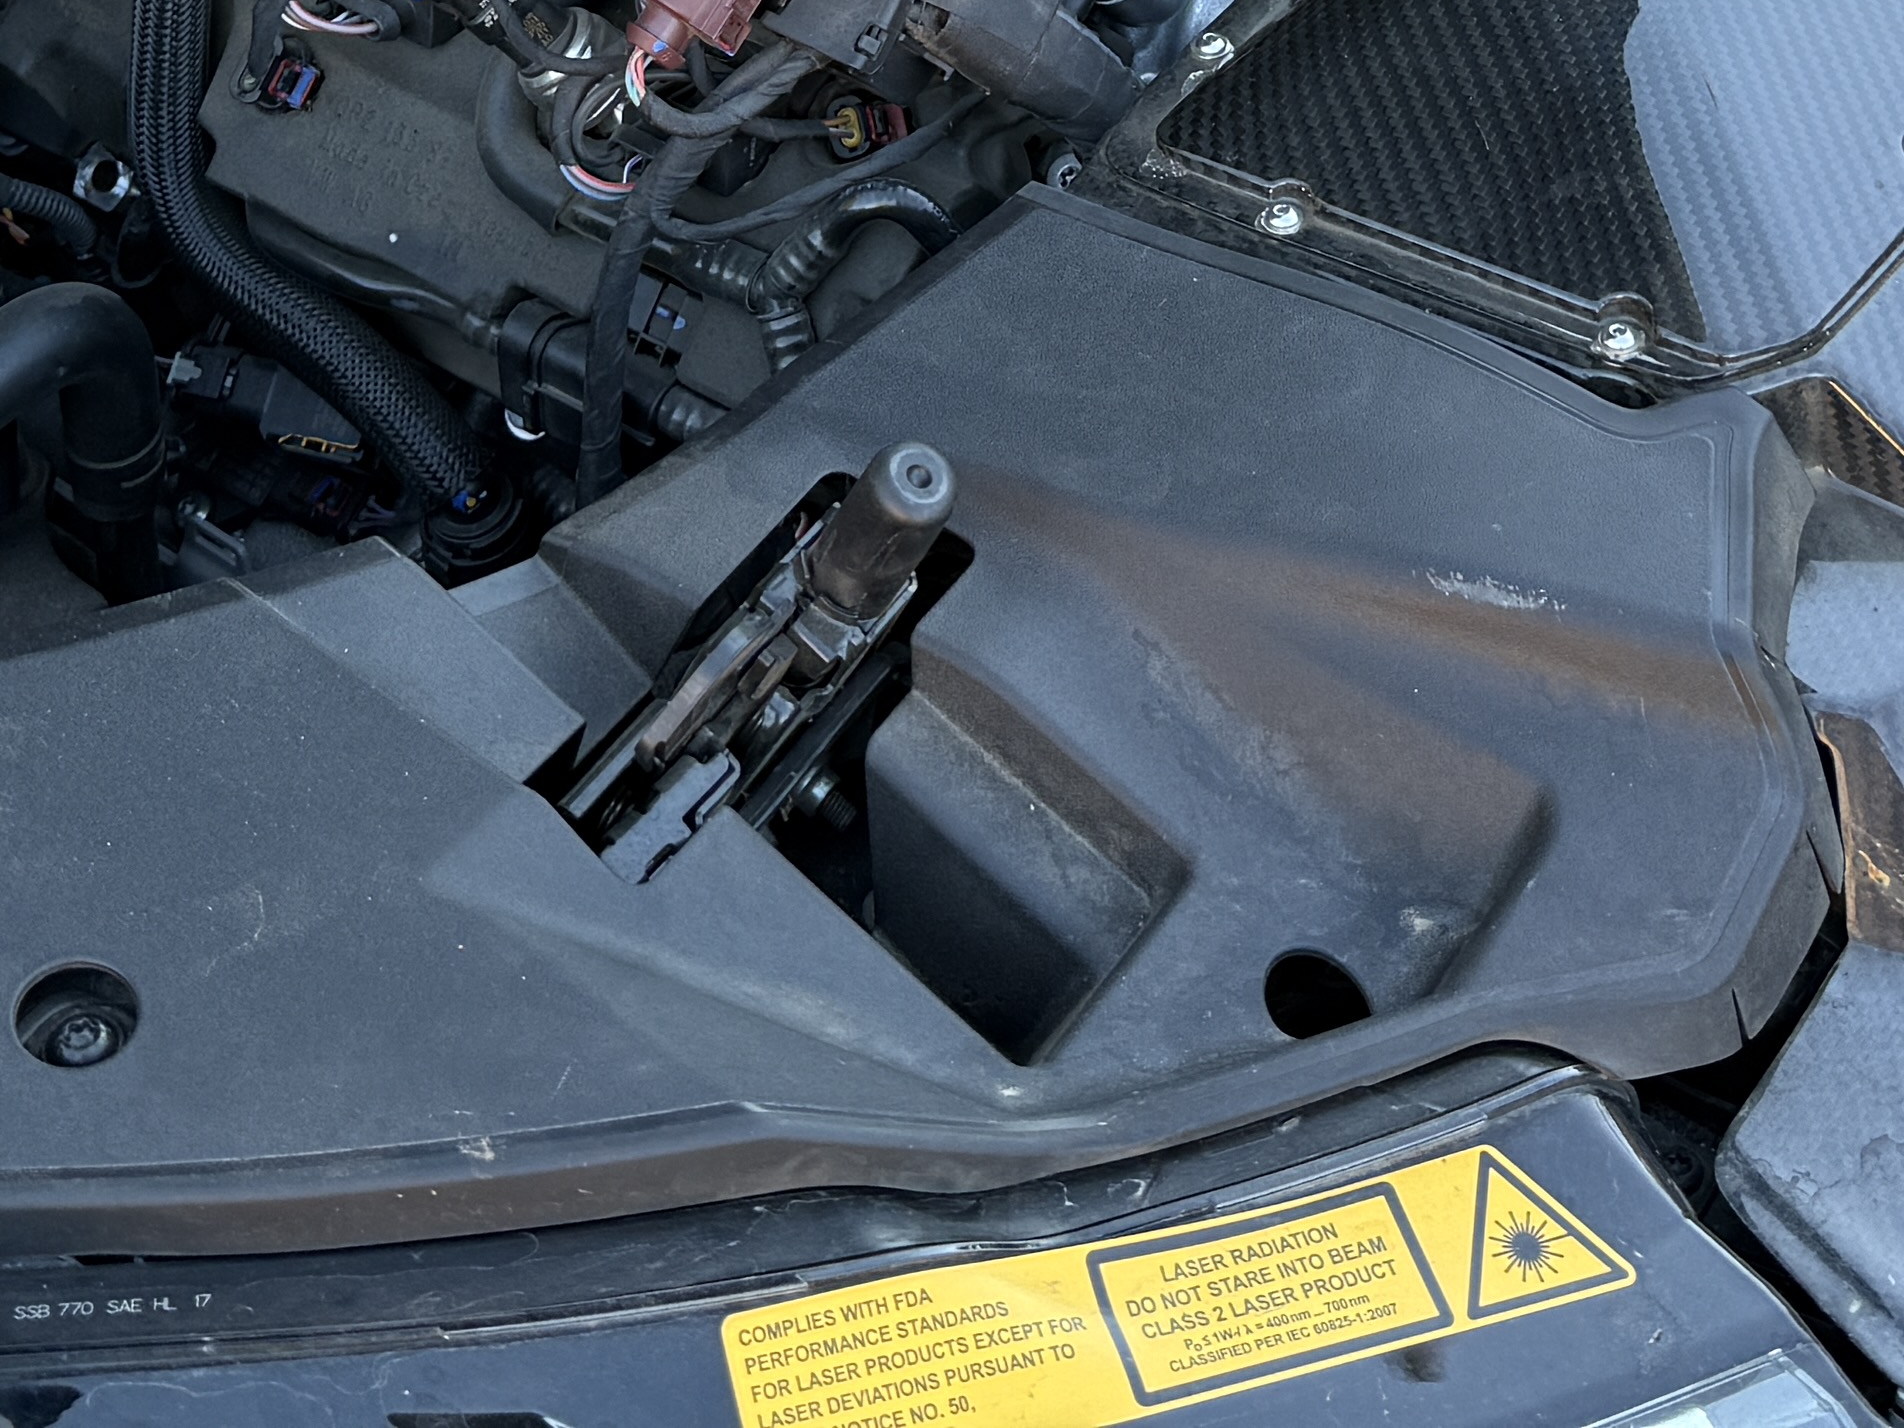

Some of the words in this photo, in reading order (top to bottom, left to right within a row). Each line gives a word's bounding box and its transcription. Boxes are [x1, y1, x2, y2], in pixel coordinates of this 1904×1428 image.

[1126, 1296, 1156, 1317] DO
[1160, 1284, 1203, 1311] NOT
[1207, 1267, 1272, 1298] STARE
[1280, 1254, 1325, 1279] INTO
[1329, 1236, 1387, 1264] BEAM
[1159, 1253, 1229, 1282] LASER
[1231, 1222, 1338, 1266] RADIATION
[13, 1304, 51, 1320] SSB
[58, 1301, 94, 1317] 770
[106, 1298, 143, 1314] SAE
[153, 1296, 177, 1311] HL
[738, 1310, 836, 1346] COMPLIES
[840, 1297, 888, 1322] WITH
[894, 1288, 933, 1311] FDA
[1142, 1310, 1210, 1339] CLASS
[1213, 1306, 1227, 1322] 2
[1229, 1288, 1300, 1318] LASER
[1302, 1259, 1397, 1298] PRODUCT
[745, 1325, 893, 1375] PERFORMANCE
[896, 1301, 1009, 1338] STANDARDS
[751, 1380, 793, 1403] FOR
[795, 1362, 861, 1392] LASER
[865, 1337, 970, 1376] PRODUCTS
[975, 1321, 1046, 1351] EXCEPT
[1049, 1316, 1088, 1336] FOR
[1169, 1343, 1252, 1373] CLASSIFIED
[1255, 1334, 1284, 1351] PER
[1288, 1327, 1311, 1342] IEC
[1313, 1303, 1398, 1335] 60825-1:2007
[757, 1398, 823, 1428] LASER
[828, 1373, 940, 1415] DEVIATIONS
[944, 1348, 1046, 1387] PURSUANT
[1049, 1344, 1075, 1361] TO
[909, 1402, 946, 1423] NO.
[949, 1395, 976, 1414] 50,
